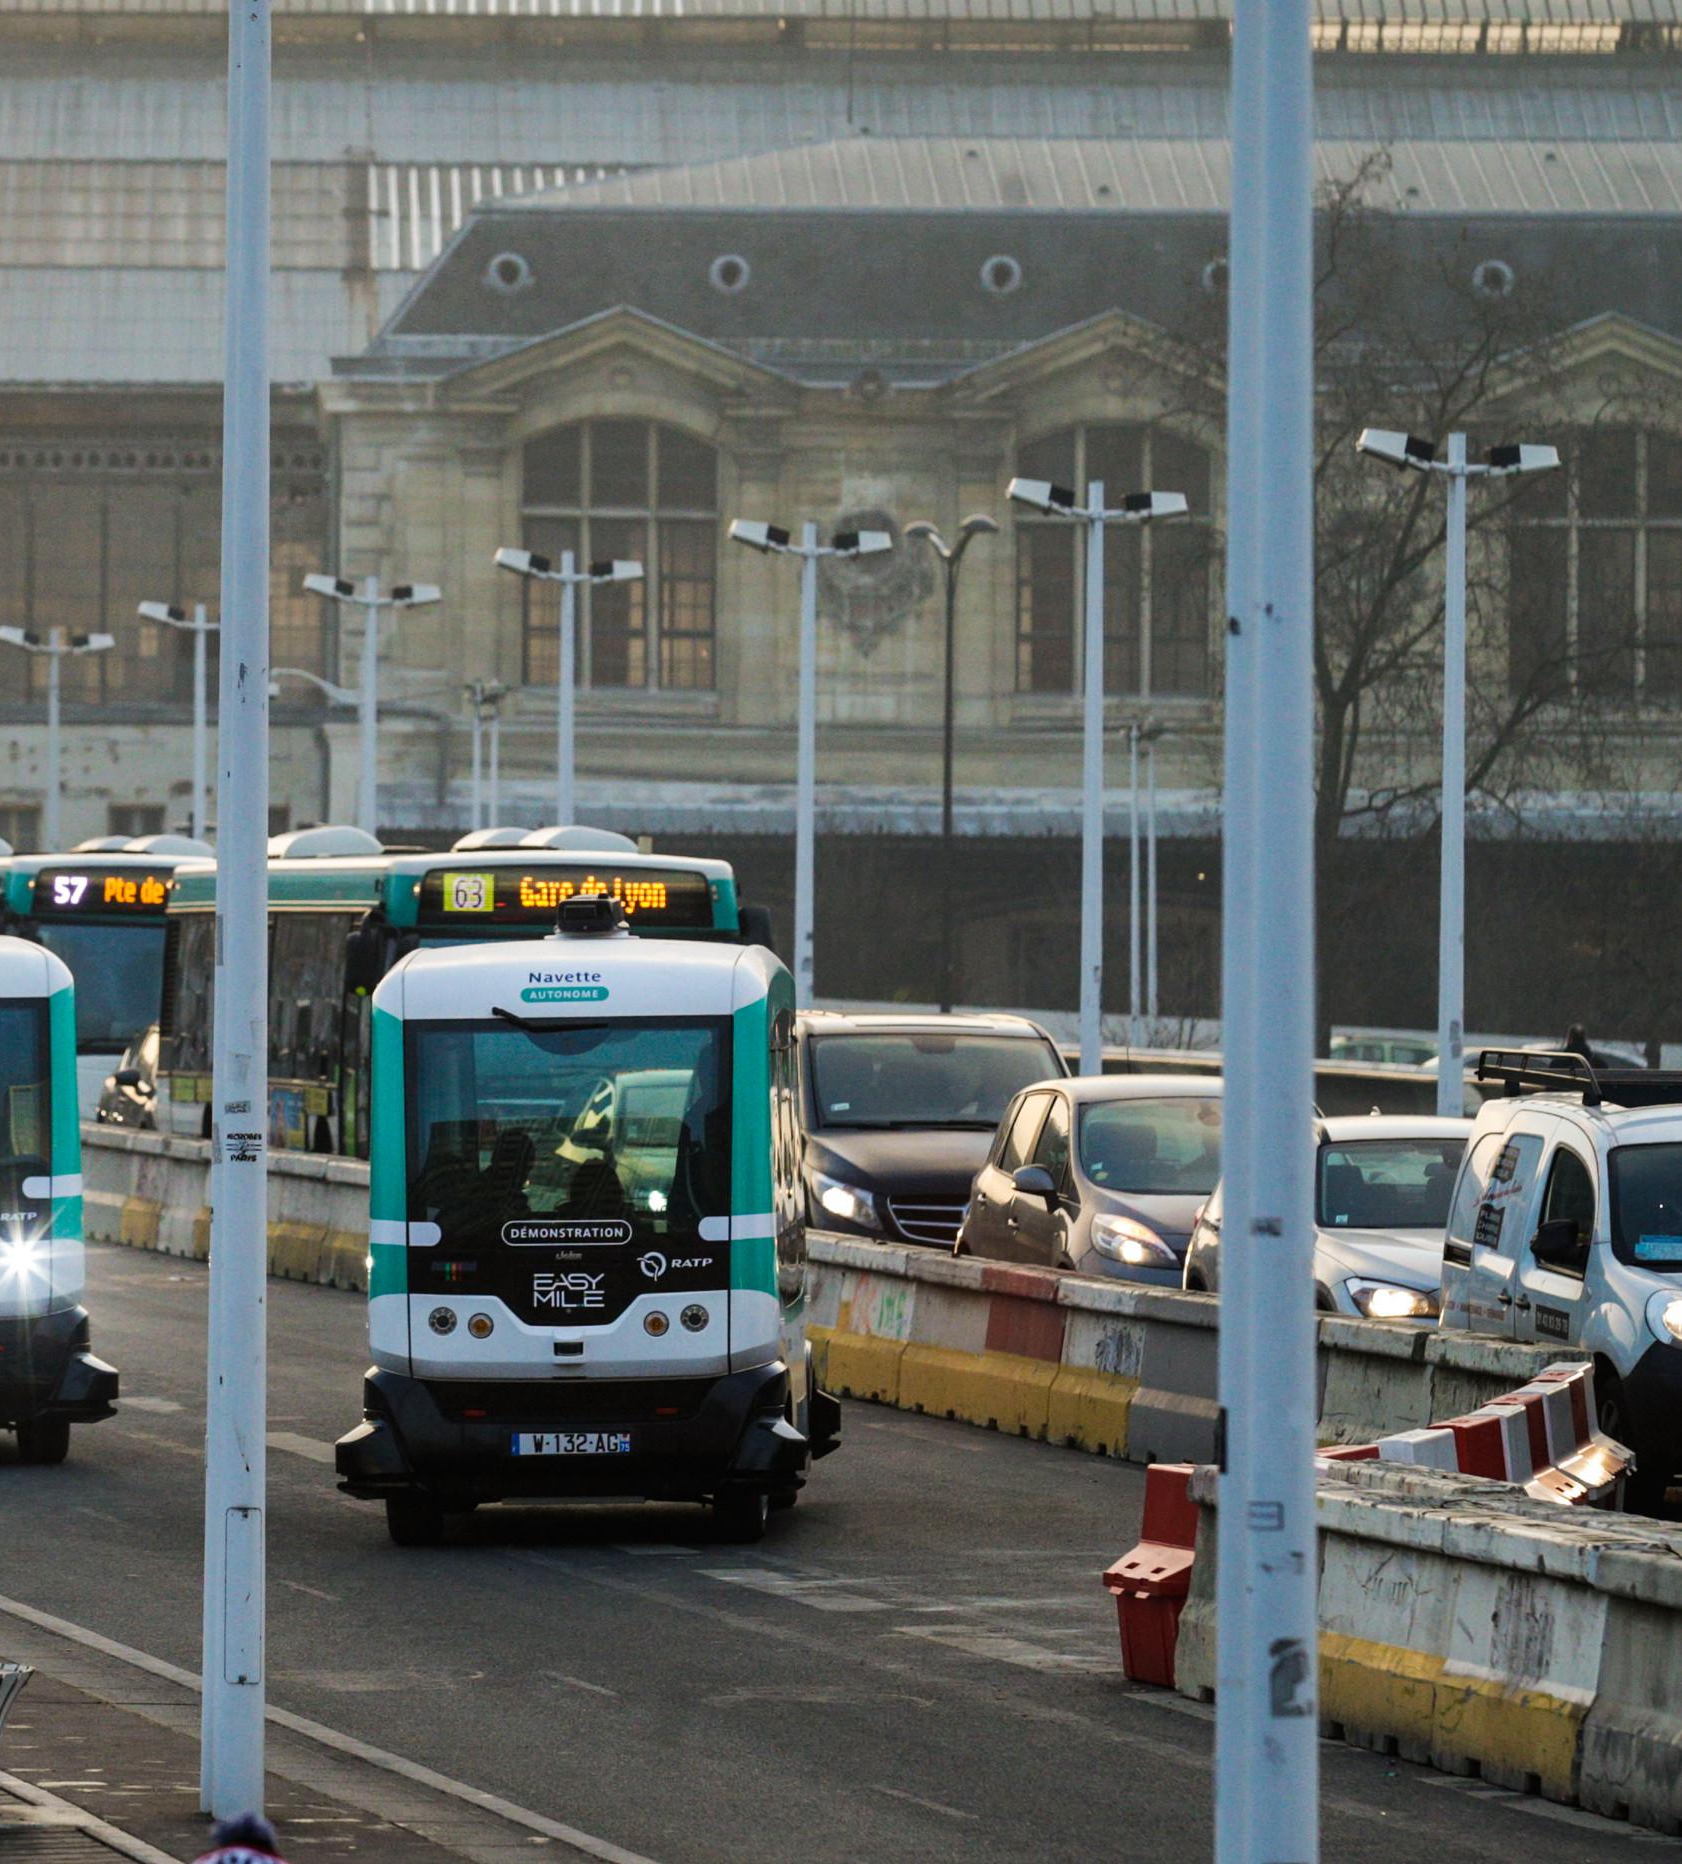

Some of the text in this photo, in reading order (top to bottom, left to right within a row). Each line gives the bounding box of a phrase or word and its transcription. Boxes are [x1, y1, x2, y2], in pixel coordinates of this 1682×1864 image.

[53, 875, 88, 905] 57
[104, 876, 165, 905] Pte de
[454, 876, 484, 908] 63
[520, 876, 574, 907] Gare
[528, 972, 601, 983] Navette
[529, 989, 599, 999] AUTONOME
[0, 1211, 38, 1222] RATP
[510, 1226, 624, 1239] DÉMONSTRATION
[671, 1257, 713, 1269] RATP
[533, 1273, 605, 1290] EASY
[533, 1290, 605, 1308] MILE
